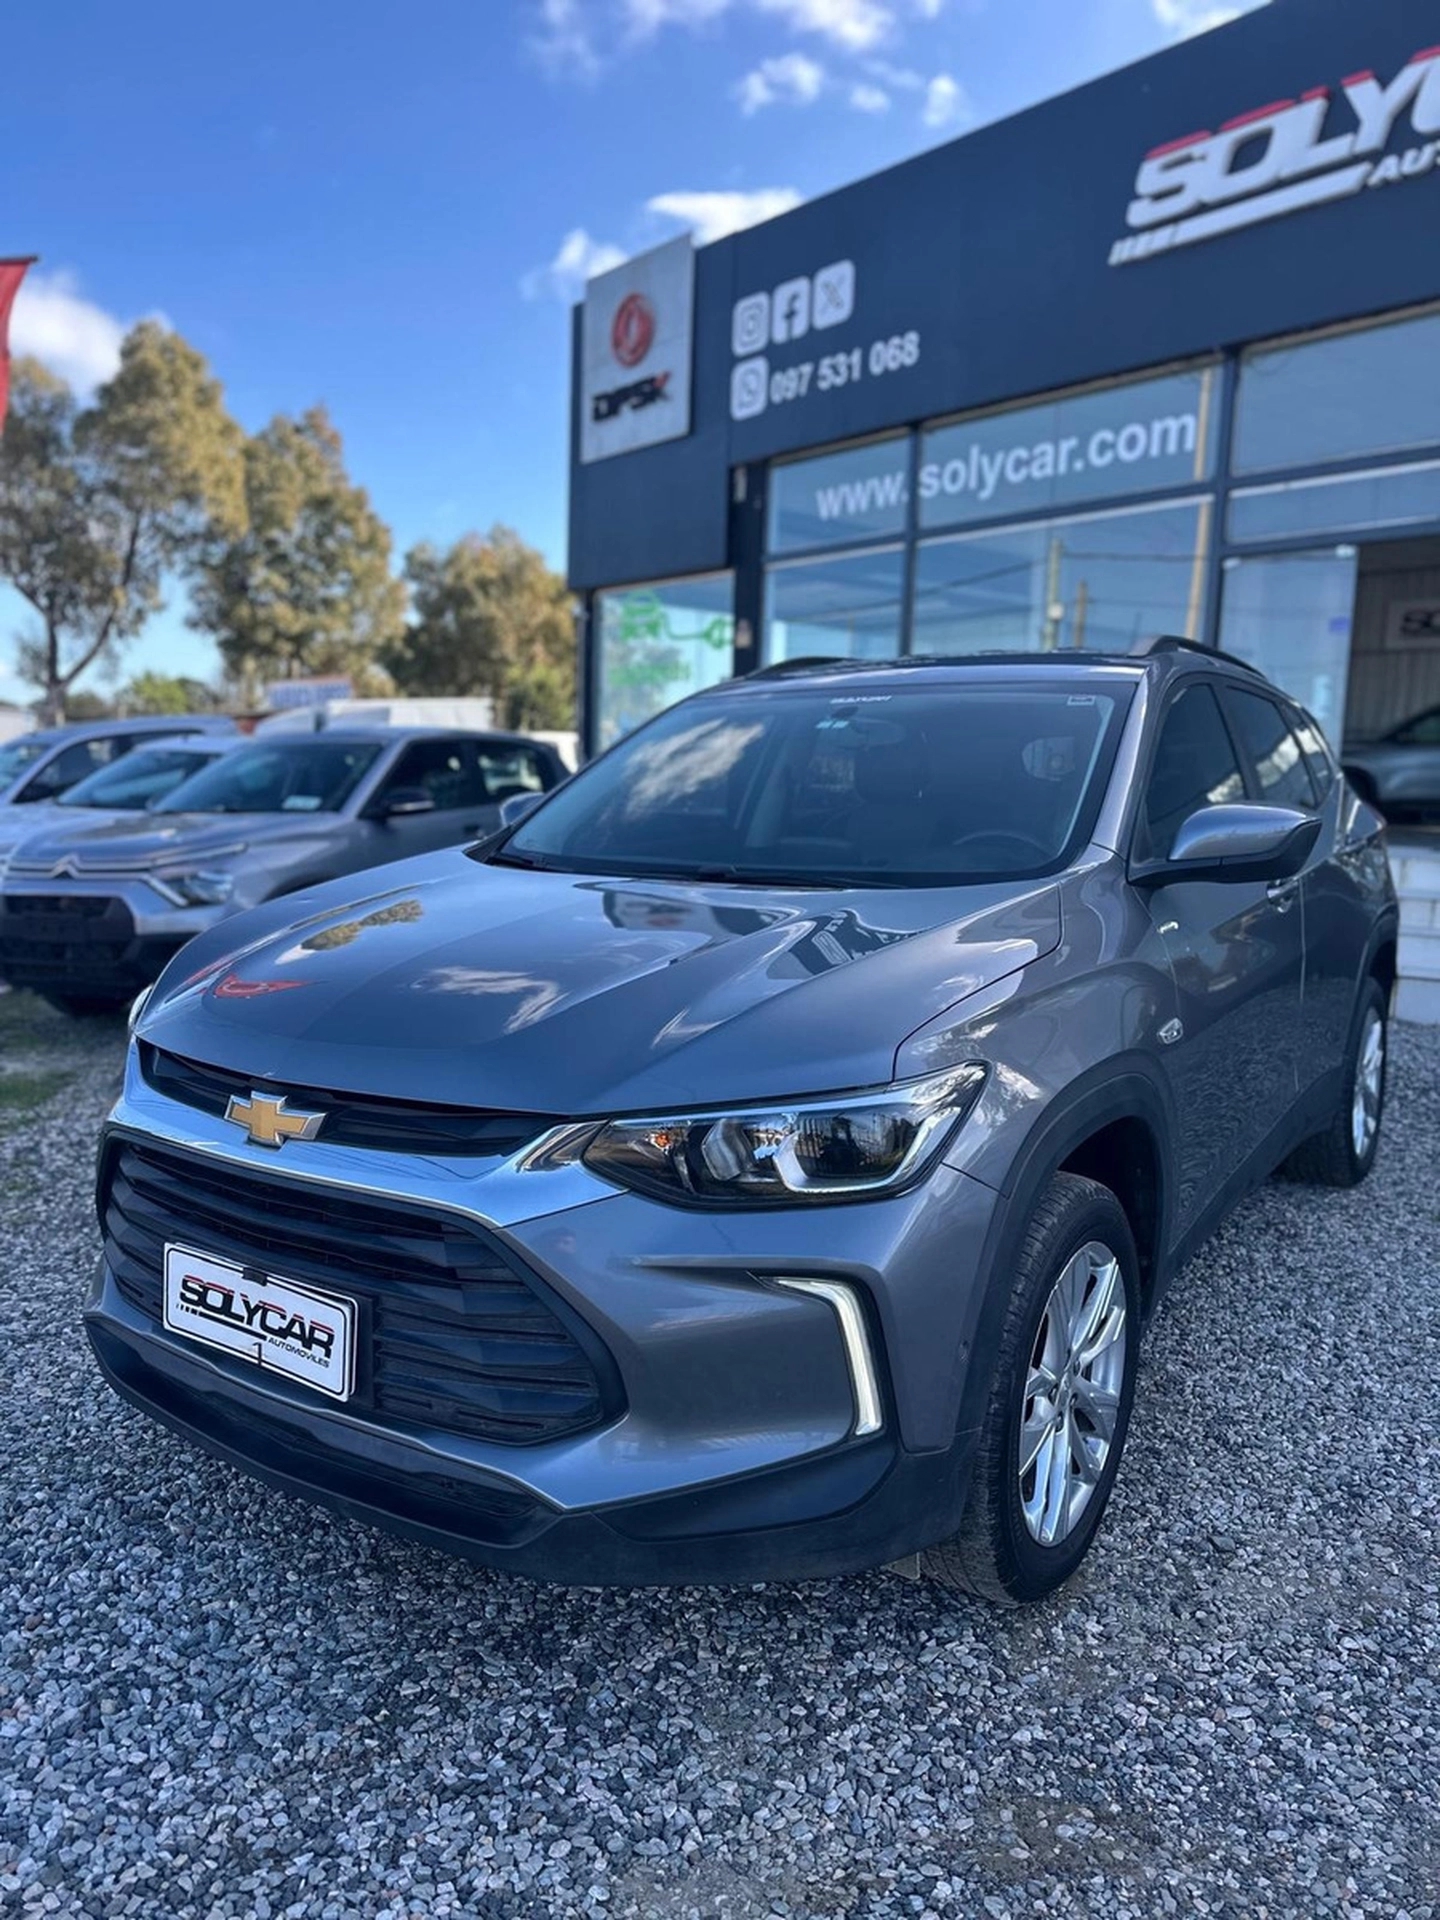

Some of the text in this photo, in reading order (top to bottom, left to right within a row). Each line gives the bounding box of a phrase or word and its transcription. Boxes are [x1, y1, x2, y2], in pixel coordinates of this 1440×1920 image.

[1367, 140, 1440, 187] AU
[770, 331, 921, 404] 097 531 068
[179, 1274, 335, 1359] SOLYCAR
[268, 1337, 330, 1368] AUTOMOVILES
